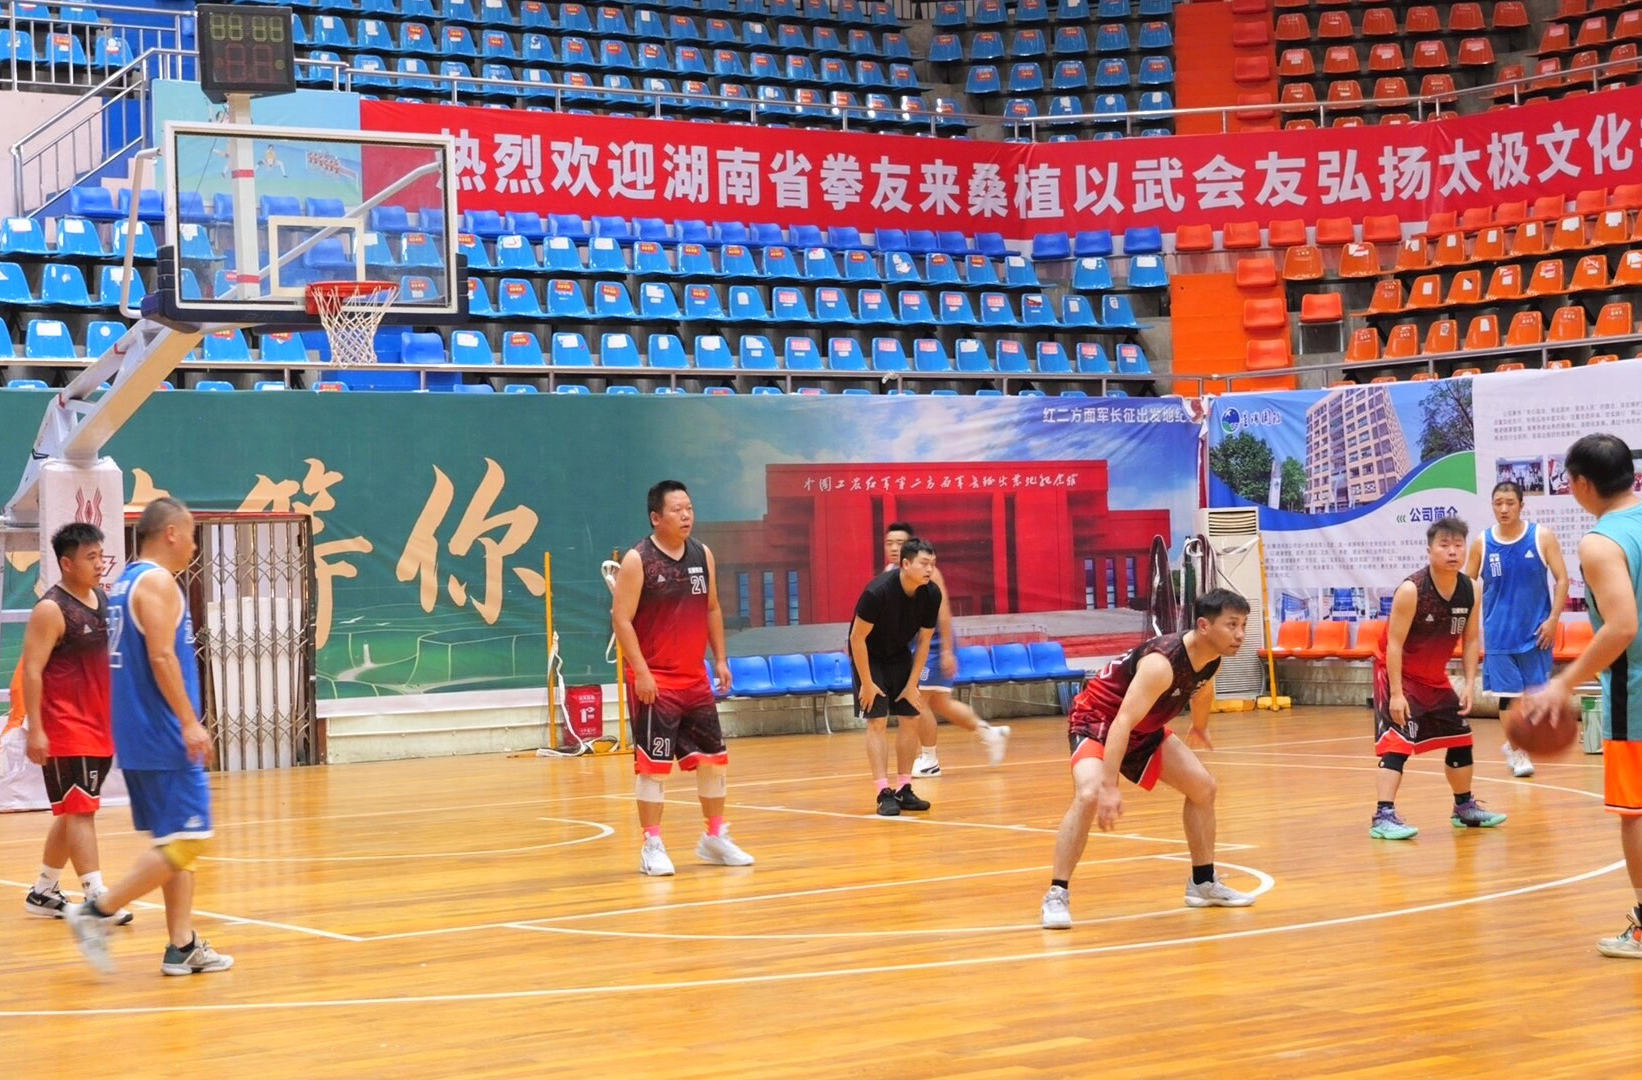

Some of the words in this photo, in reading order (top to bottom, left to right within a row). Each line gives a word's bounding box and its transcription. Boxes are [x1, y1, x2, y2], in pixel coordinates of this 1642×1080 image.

[435, 113, 1642, 220] 热烈欢迎湖南省拳友来桑植以武会友弘扬太极文化
[1490, 562, 1502, 577] 11
[690, 575, 707, 595] 21
[652, 737, 671, 757] 21
